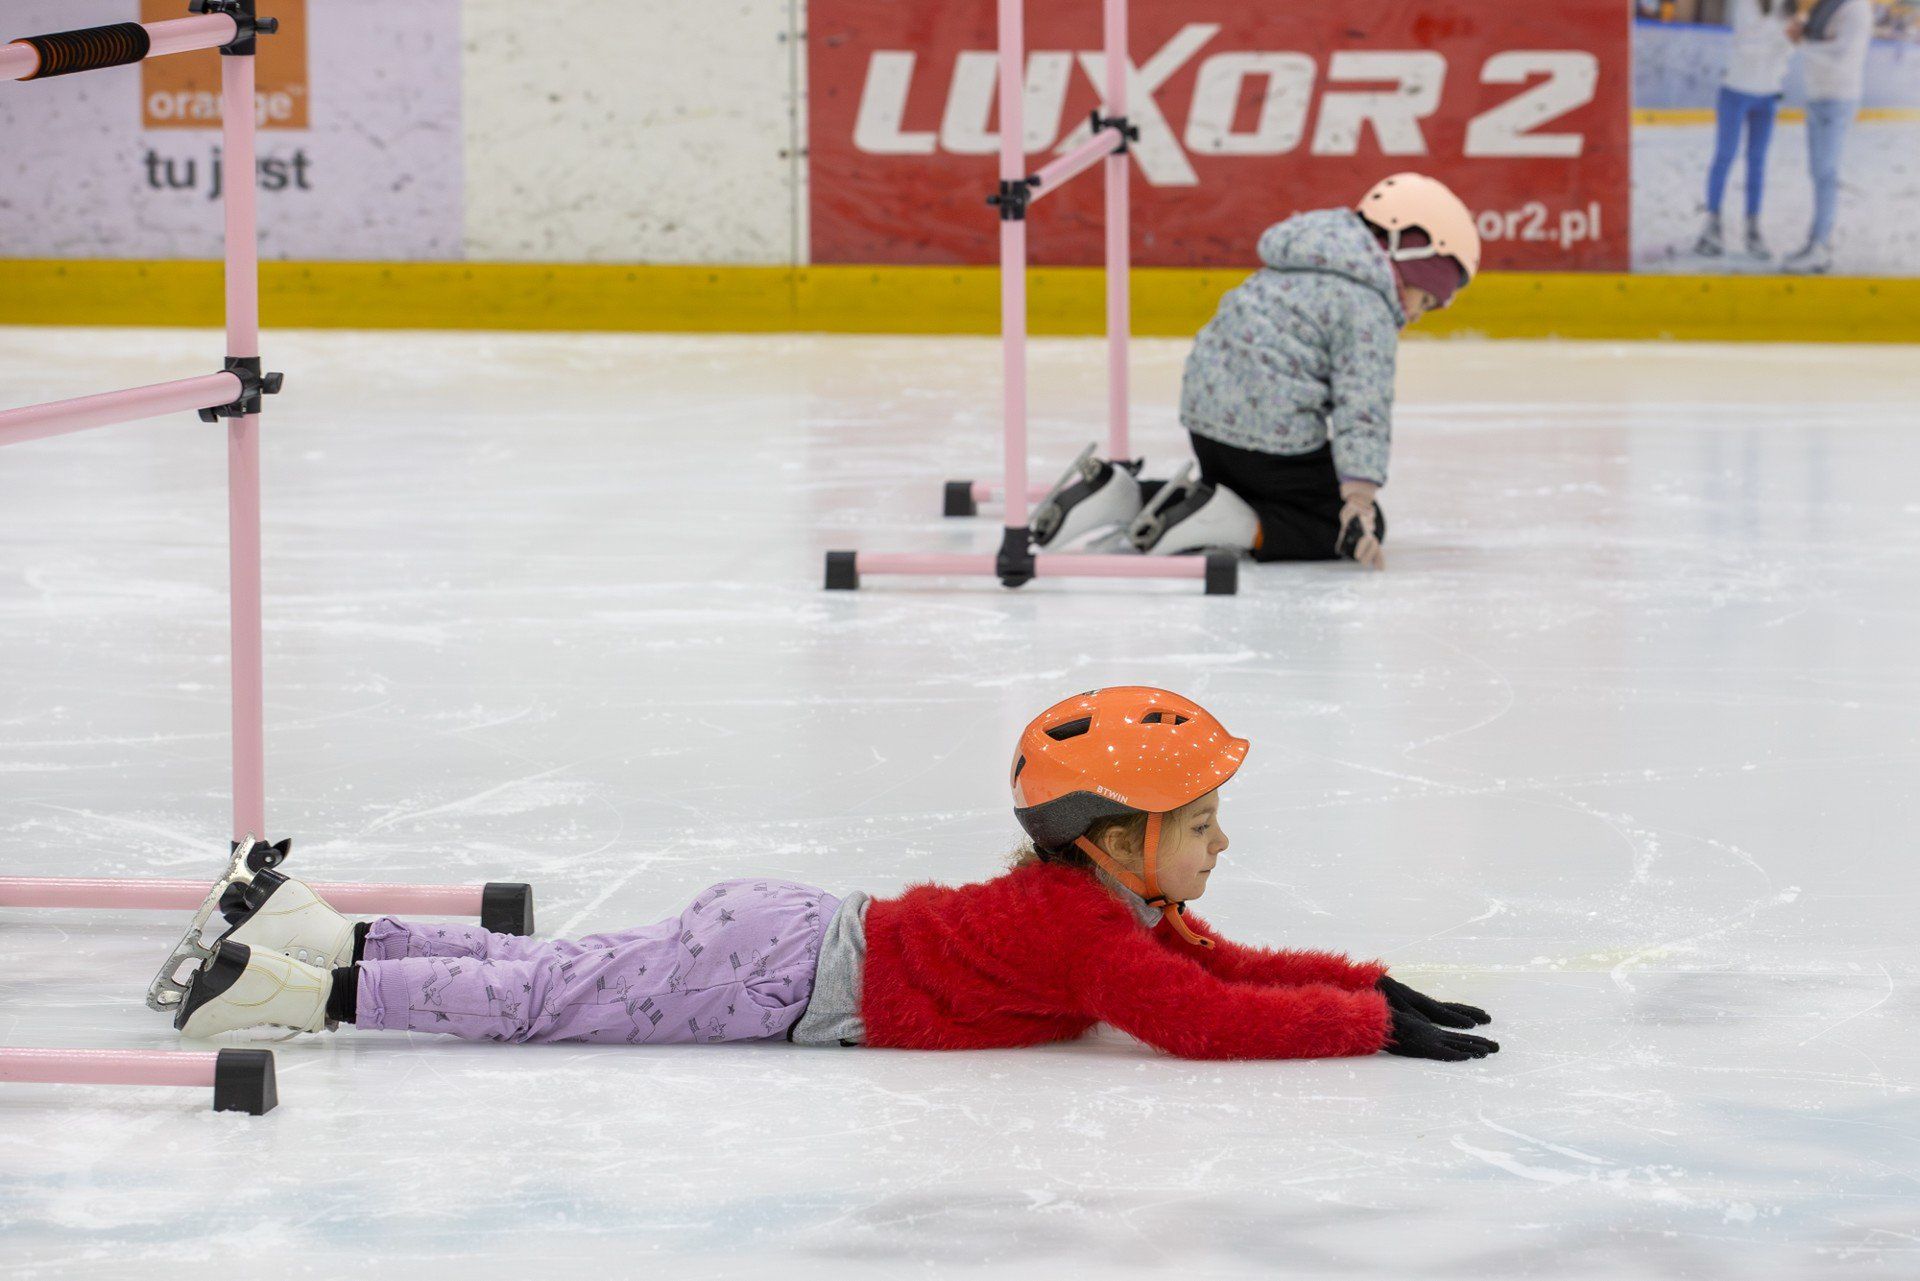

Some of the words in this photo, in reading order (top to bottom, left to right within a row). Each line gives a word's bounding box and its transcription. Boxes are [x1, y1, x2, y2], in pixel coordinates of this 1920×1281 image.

[149, 91, 292, 127] orage
[854, 23, 1447, 186] LUXOR
[1463, 50, 1599, 158] 2
[144, 149, 196, 189] tu
[207, 146, 312, 200] jst
[1476, 201, 1600, 249] or2.pl
[1096, 784, 1129, 805] BTWIN
